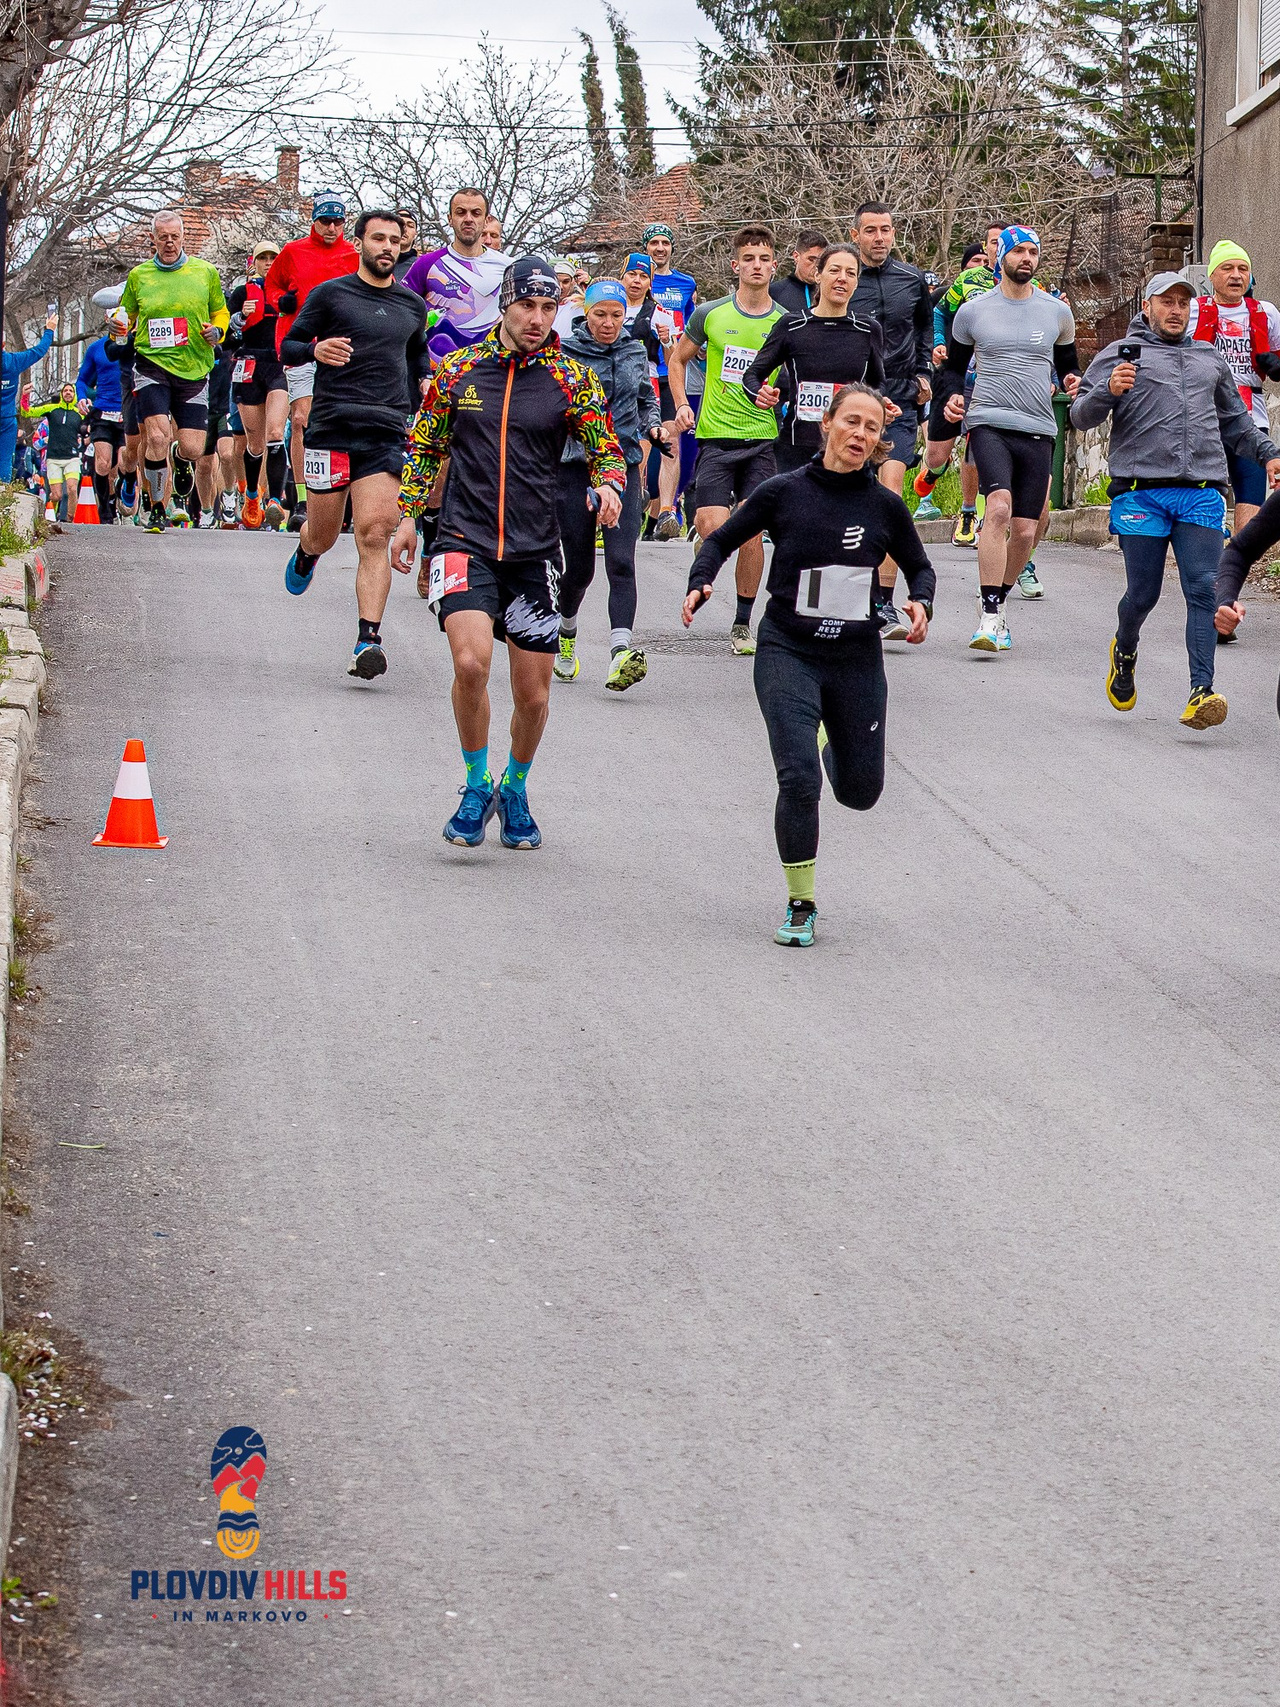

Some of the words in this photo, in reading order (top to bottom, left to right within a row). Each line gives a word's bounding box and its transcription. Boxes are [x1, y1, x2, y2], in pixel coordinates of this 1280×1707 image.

[150, 326, 172, 337] 2289
[799, 394, 830, 408] 2306
[305, 460, 325, 475] 2131
[818, 626, 842, 634] RESS
